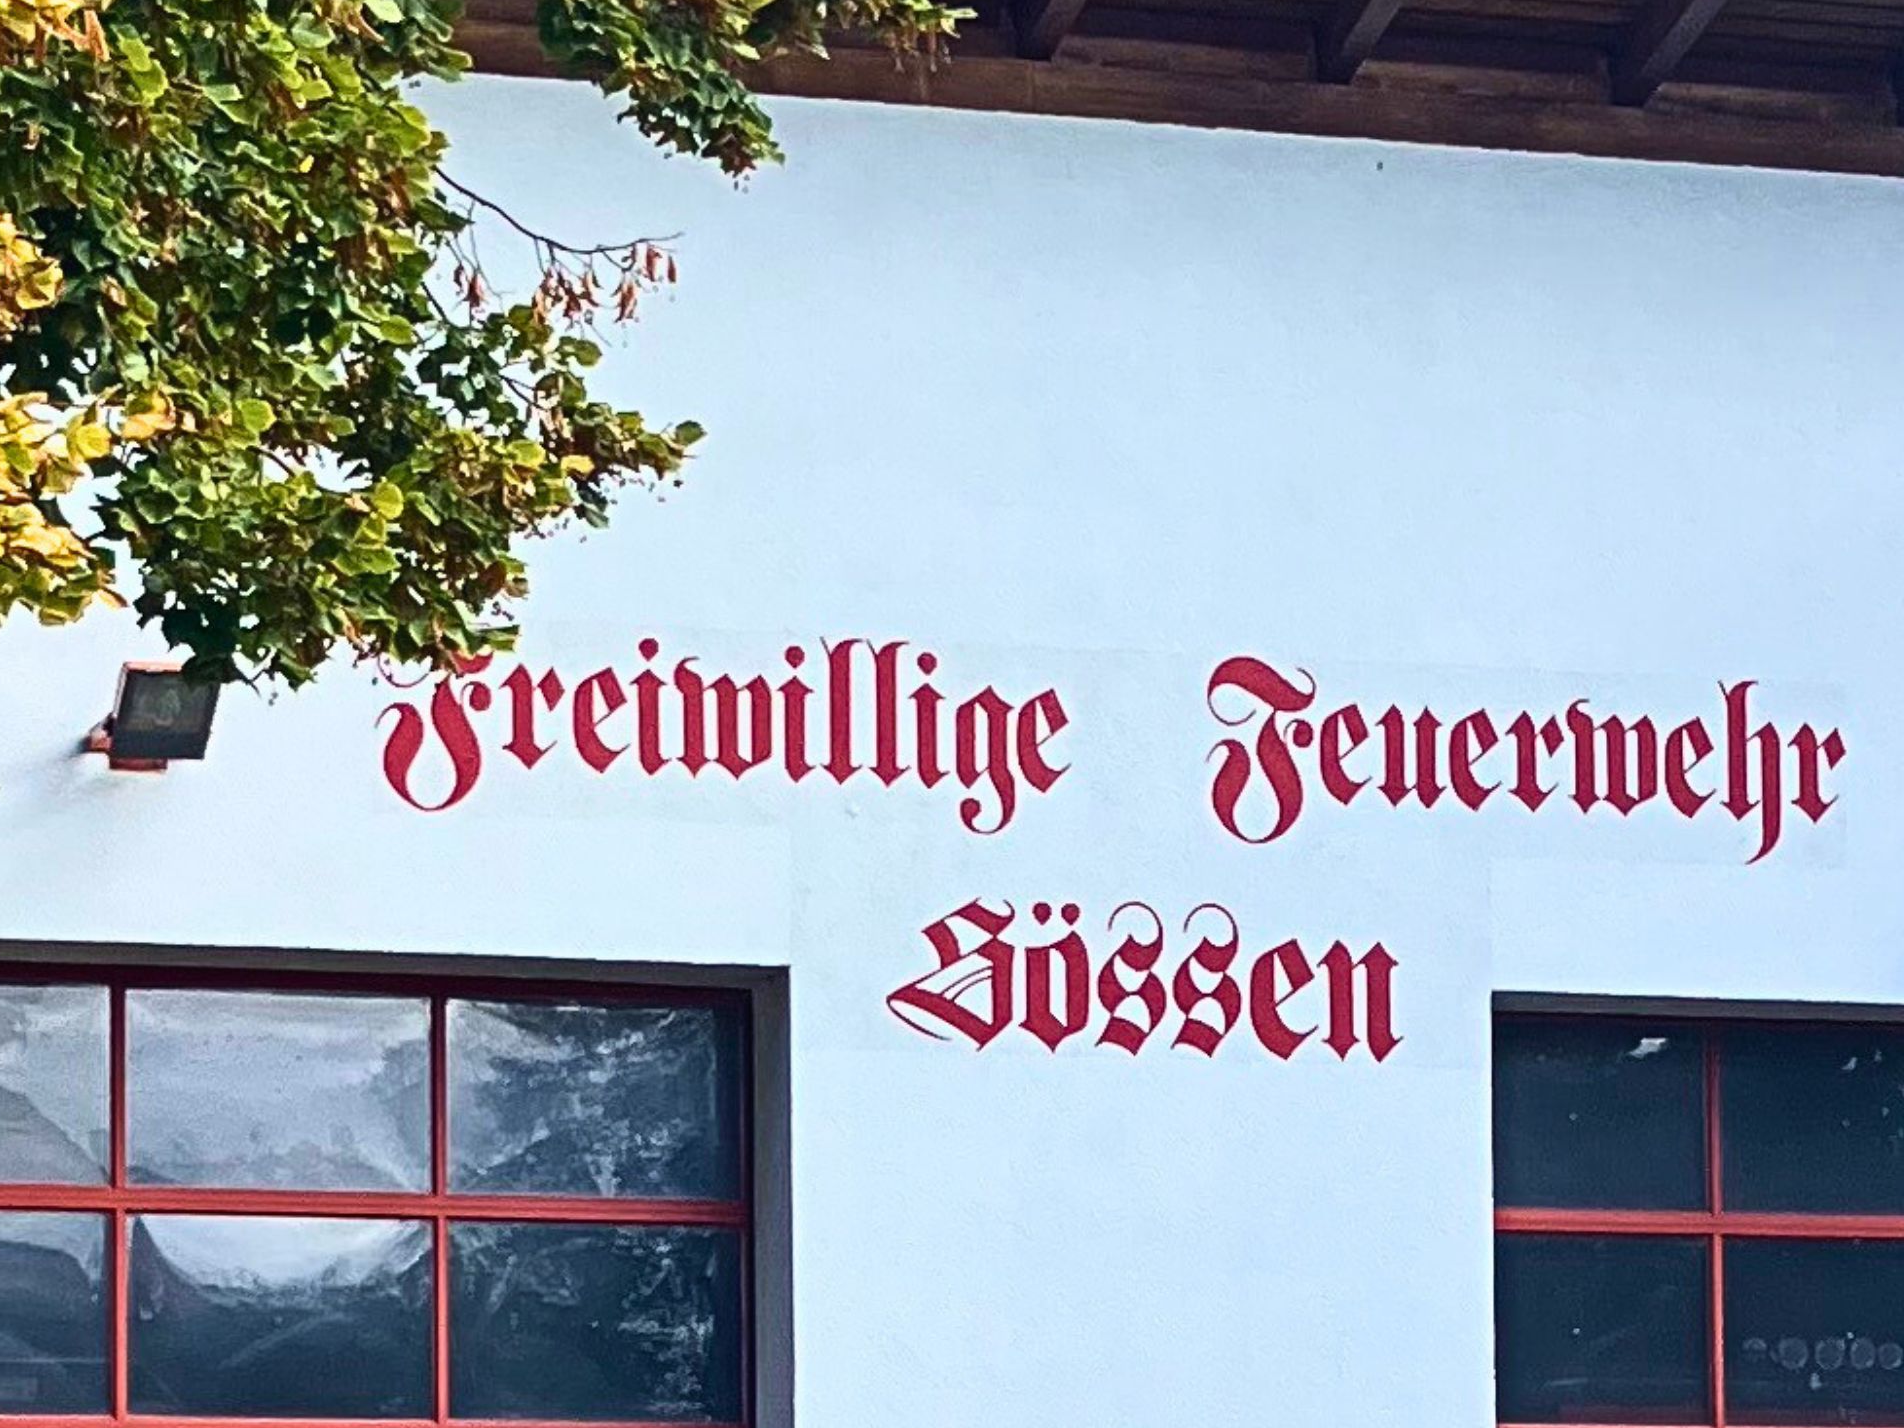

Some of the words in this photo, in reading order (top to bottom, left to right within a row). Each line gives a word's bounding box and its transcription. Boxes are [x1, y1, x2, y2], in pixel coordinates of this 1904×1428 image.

[374, 636, 1072, 834] Freiwillige
[1206, 656, 1847, 864] Feuerwehr
[886, 897, 1404, 1063] Sössen
